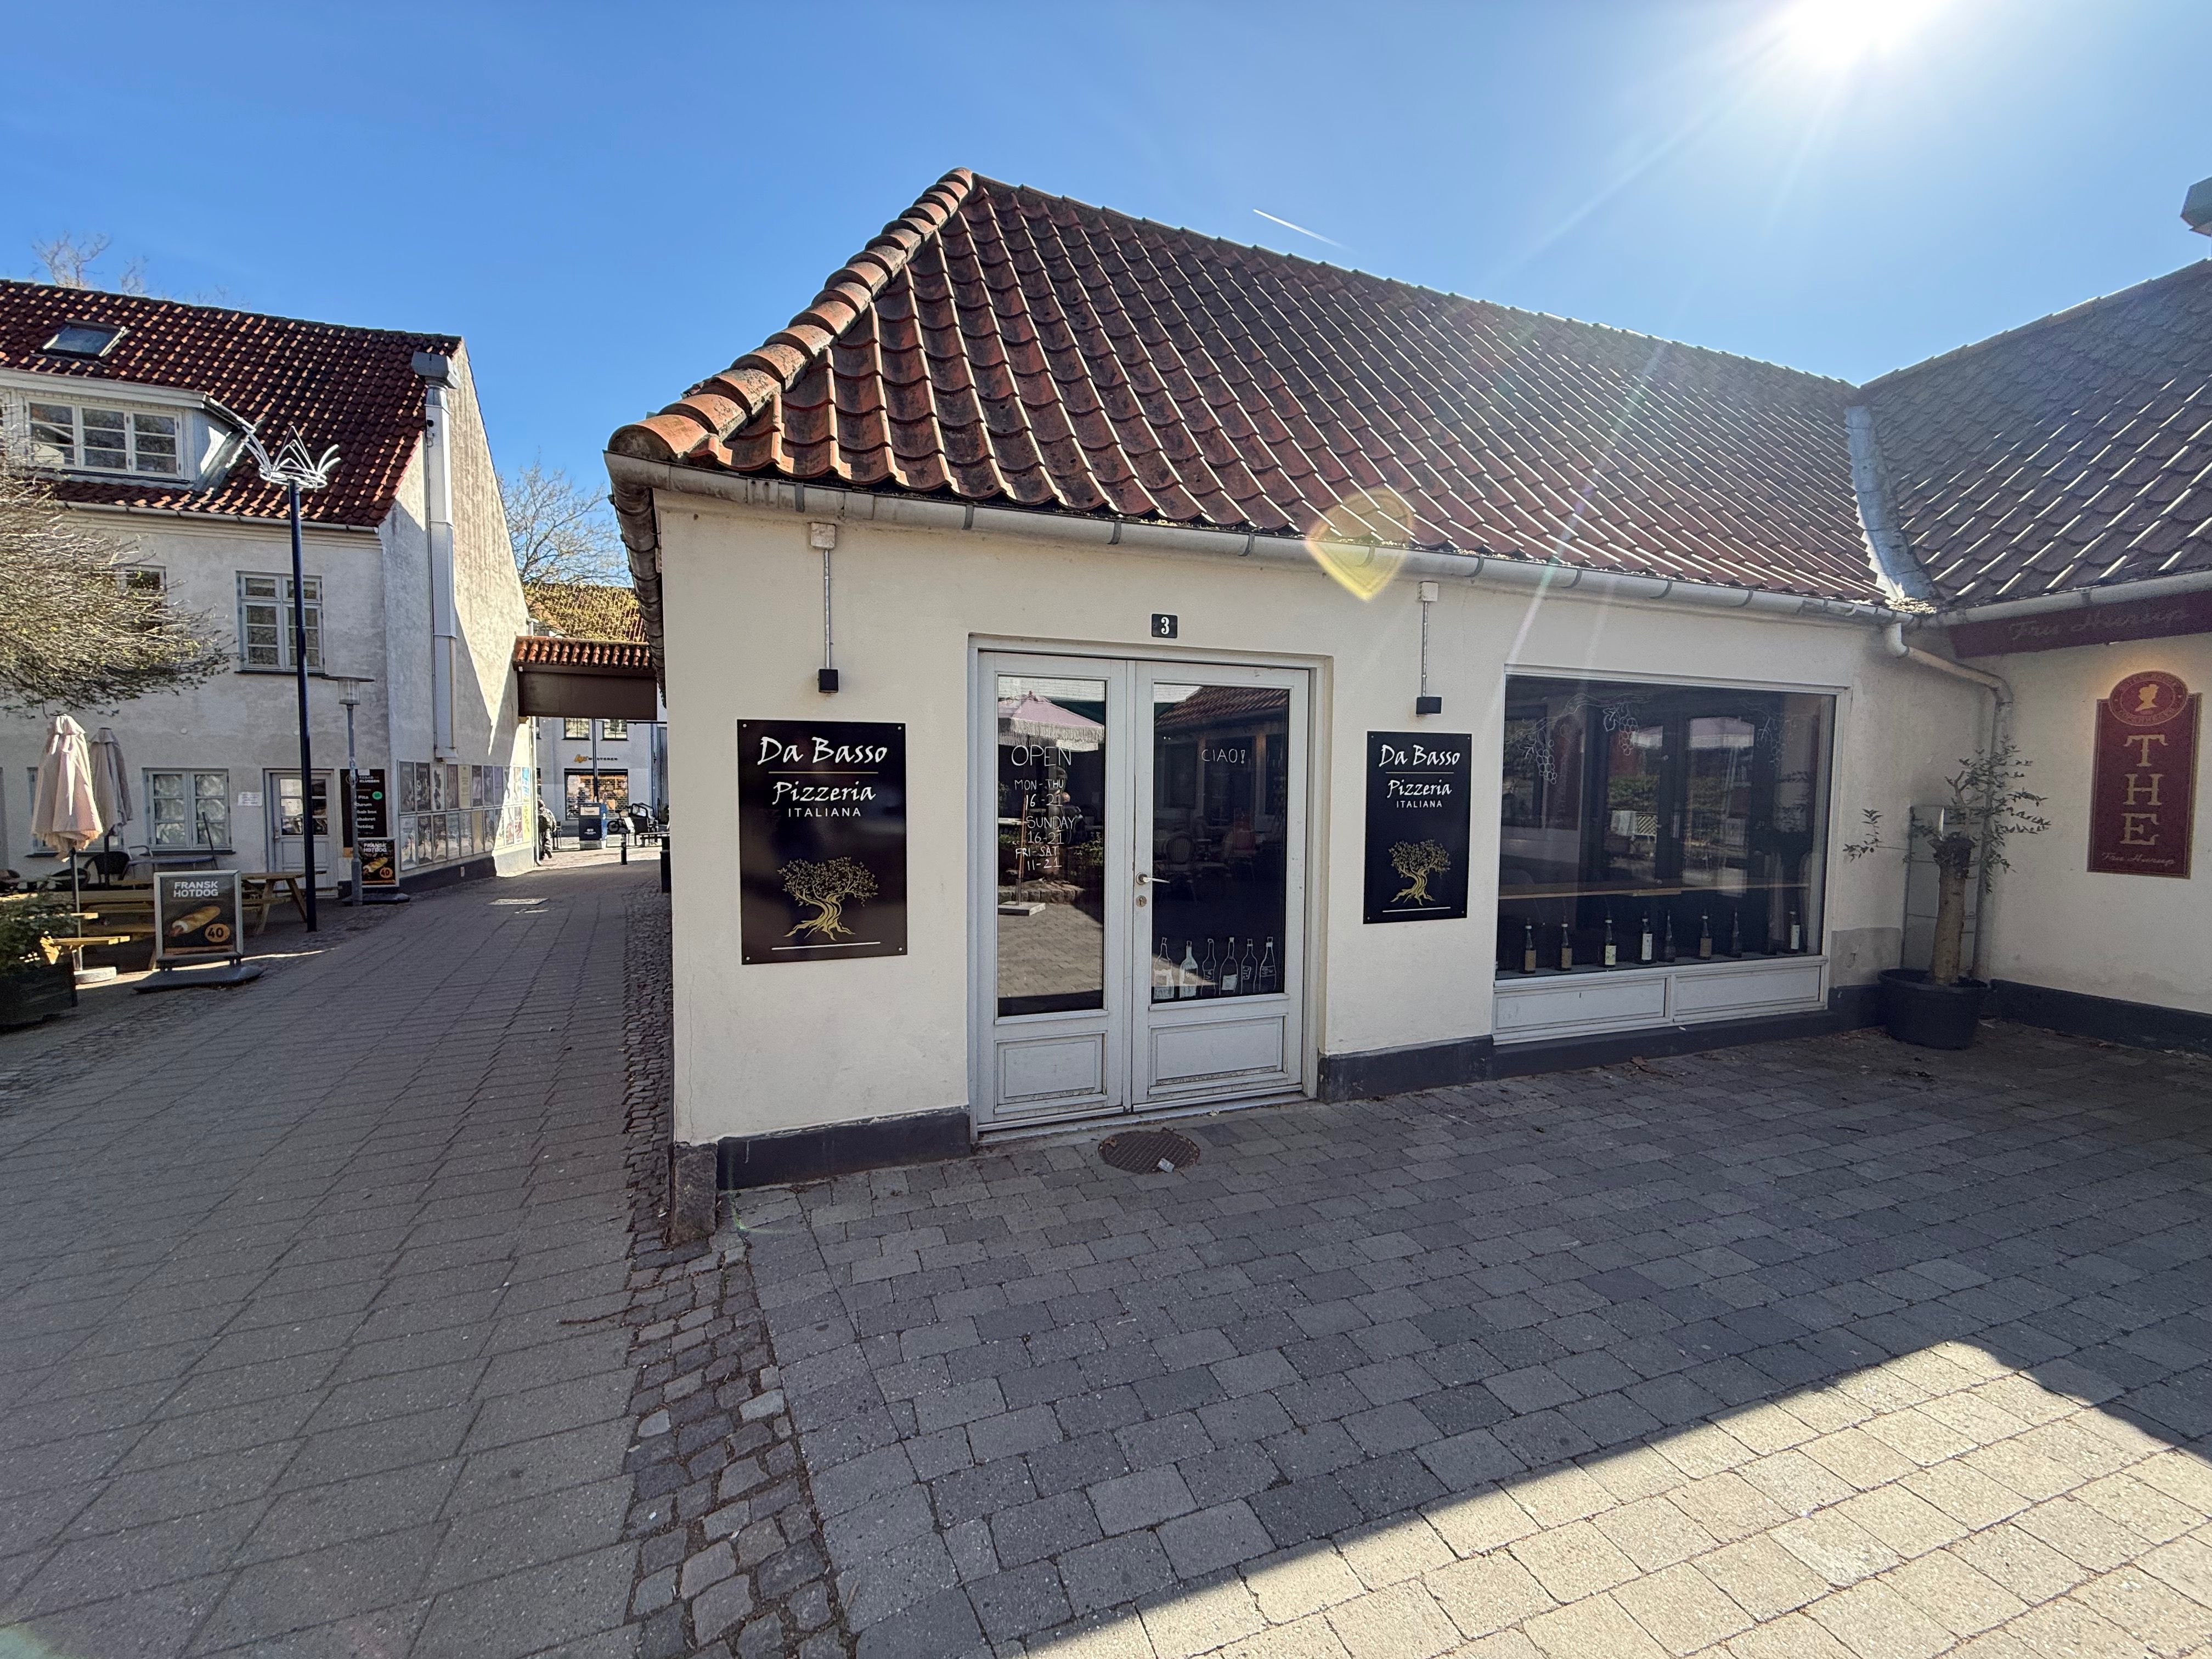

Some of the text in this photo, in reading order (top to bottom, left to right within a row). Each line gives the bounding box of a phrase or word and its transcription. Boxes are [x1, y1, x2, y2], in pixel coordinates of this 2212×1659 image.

[1161, 617, 1170, 635] 3
[757, 736, 888, 765] Da Basso
[1011, 744, 1071, 766] OPEN
[1201, 748, 1245, 764] CIAO!
[1379, 744, 1460, 767] Da Basso
[772, 781, 877, 805] Pizzeria
[1387, 779, 1452, 798] Pizzeria
[2119, 734, 2169, 845] THE
[788, 808, 861, 817] ITALIANA
[1396, 800, 1442, 808] ITALIANA
[1026, 816, 1075, 830] SUNDAY
[173, 889, 219, 898] HOTDOG
[174, 881, 218, 889] FRANSK
[207, 927, 224, 938] 40
